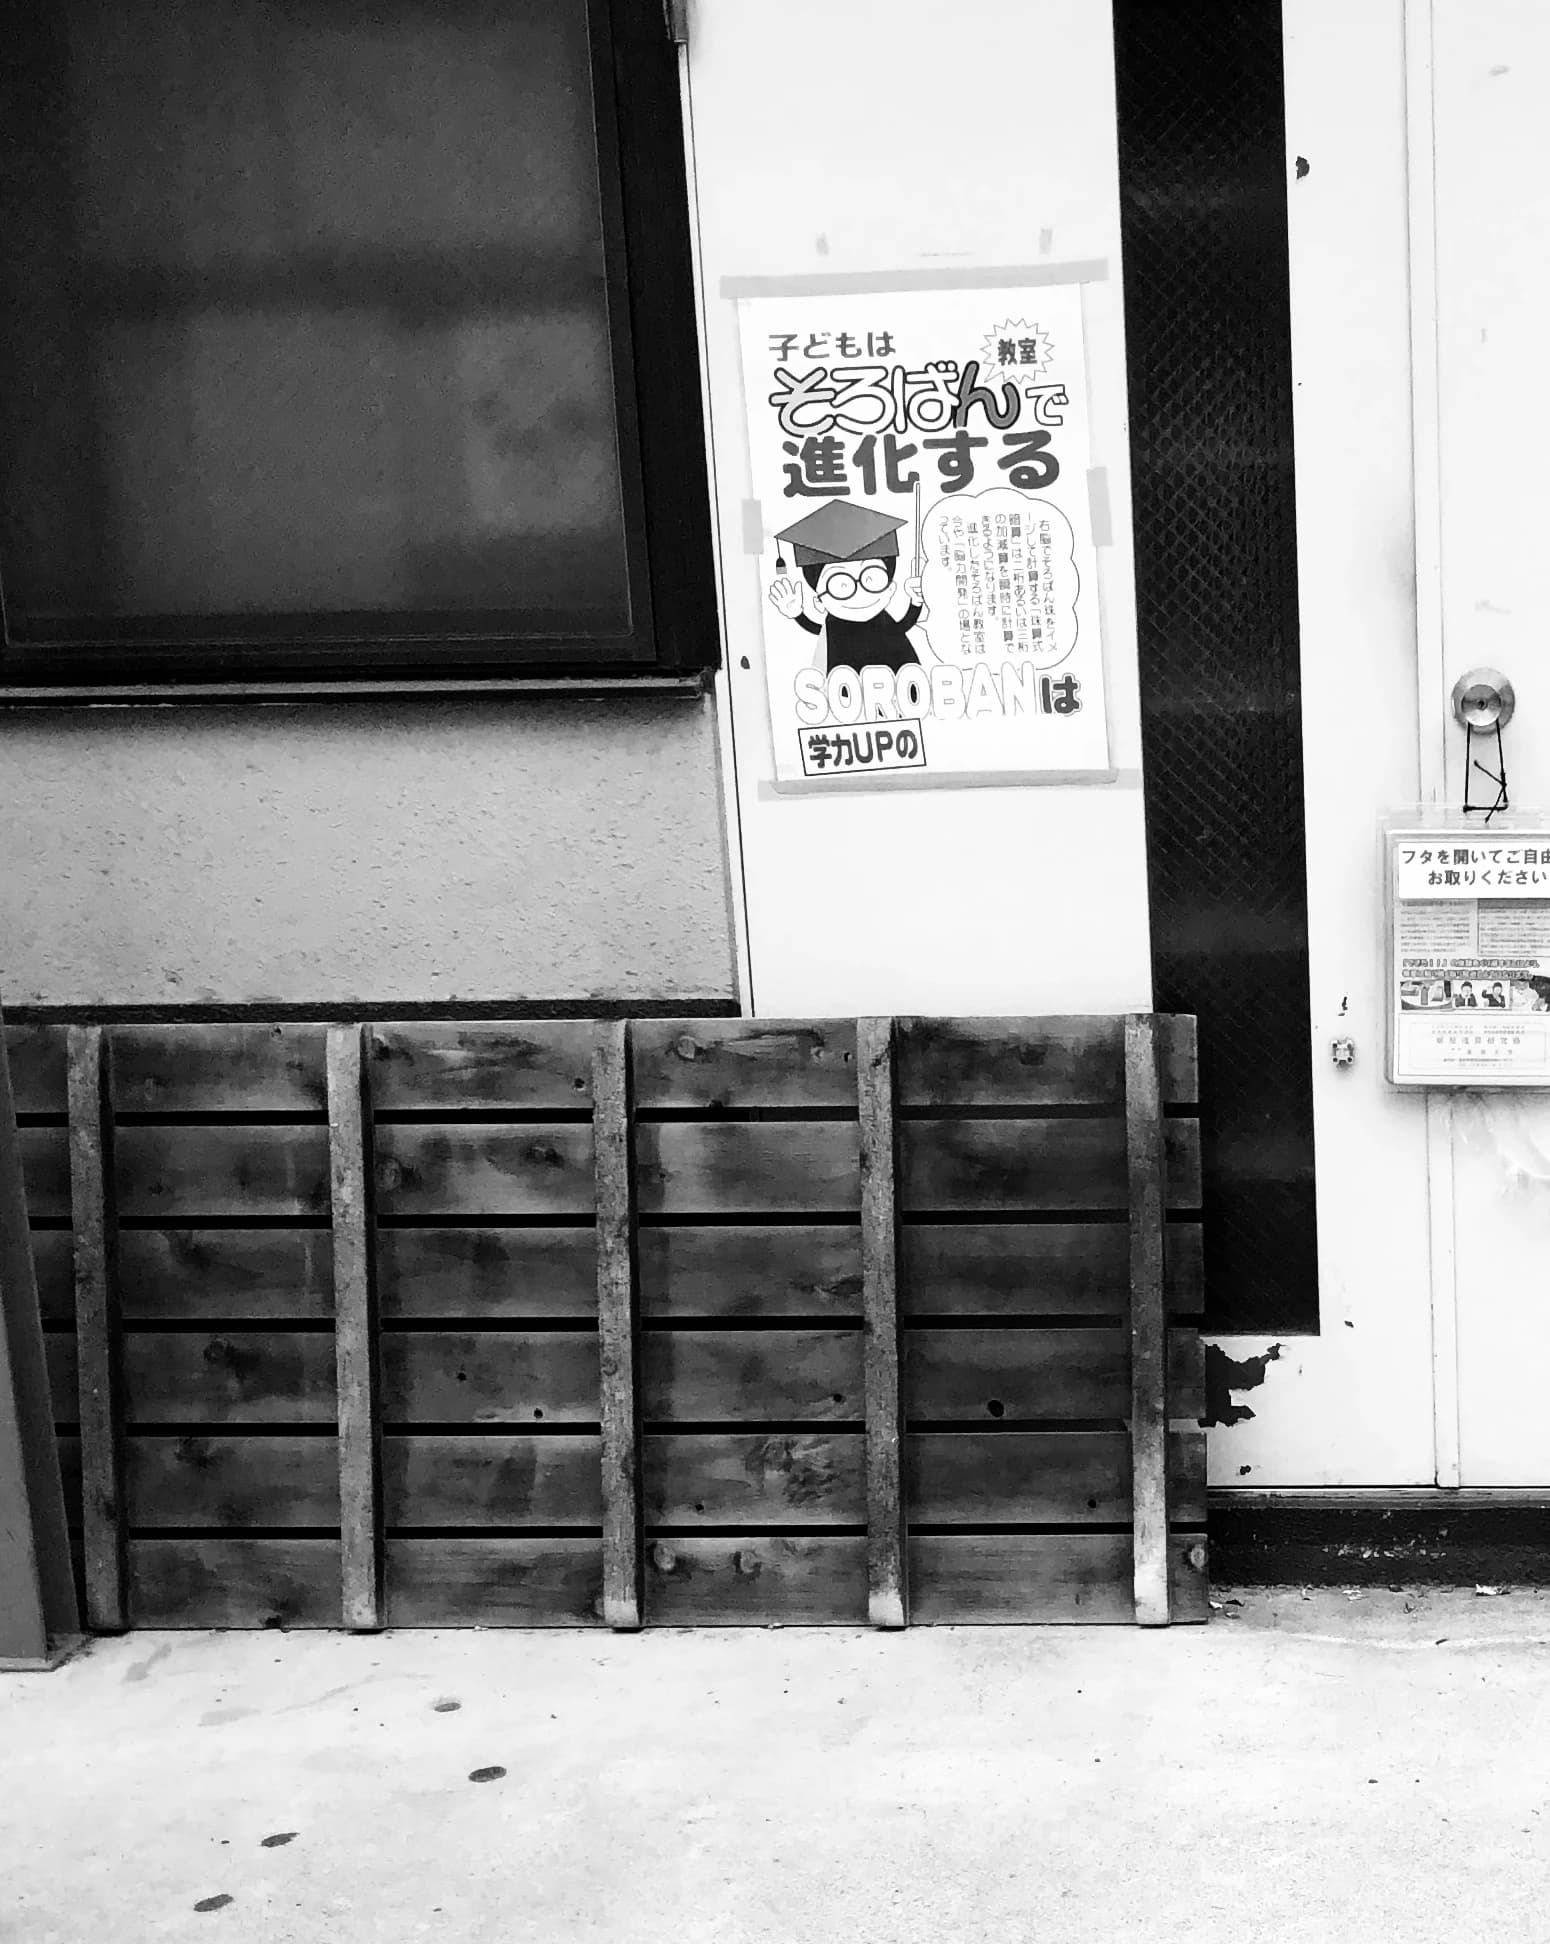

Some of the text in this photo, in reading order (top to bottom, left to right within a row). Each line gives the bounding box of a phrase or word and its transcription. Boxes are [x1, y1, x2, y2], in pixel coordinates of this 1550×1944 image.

[769, 332, 896, 361] 子どもは
[998, 338, 1037, 366] 教室
[769, 361, 1069, 439] そろばんで
[782, 430, 1060, 498] 進化する
[808, 729, 918, 768] 学力UPの
[1428, 870, 1547, 885] お取りください
